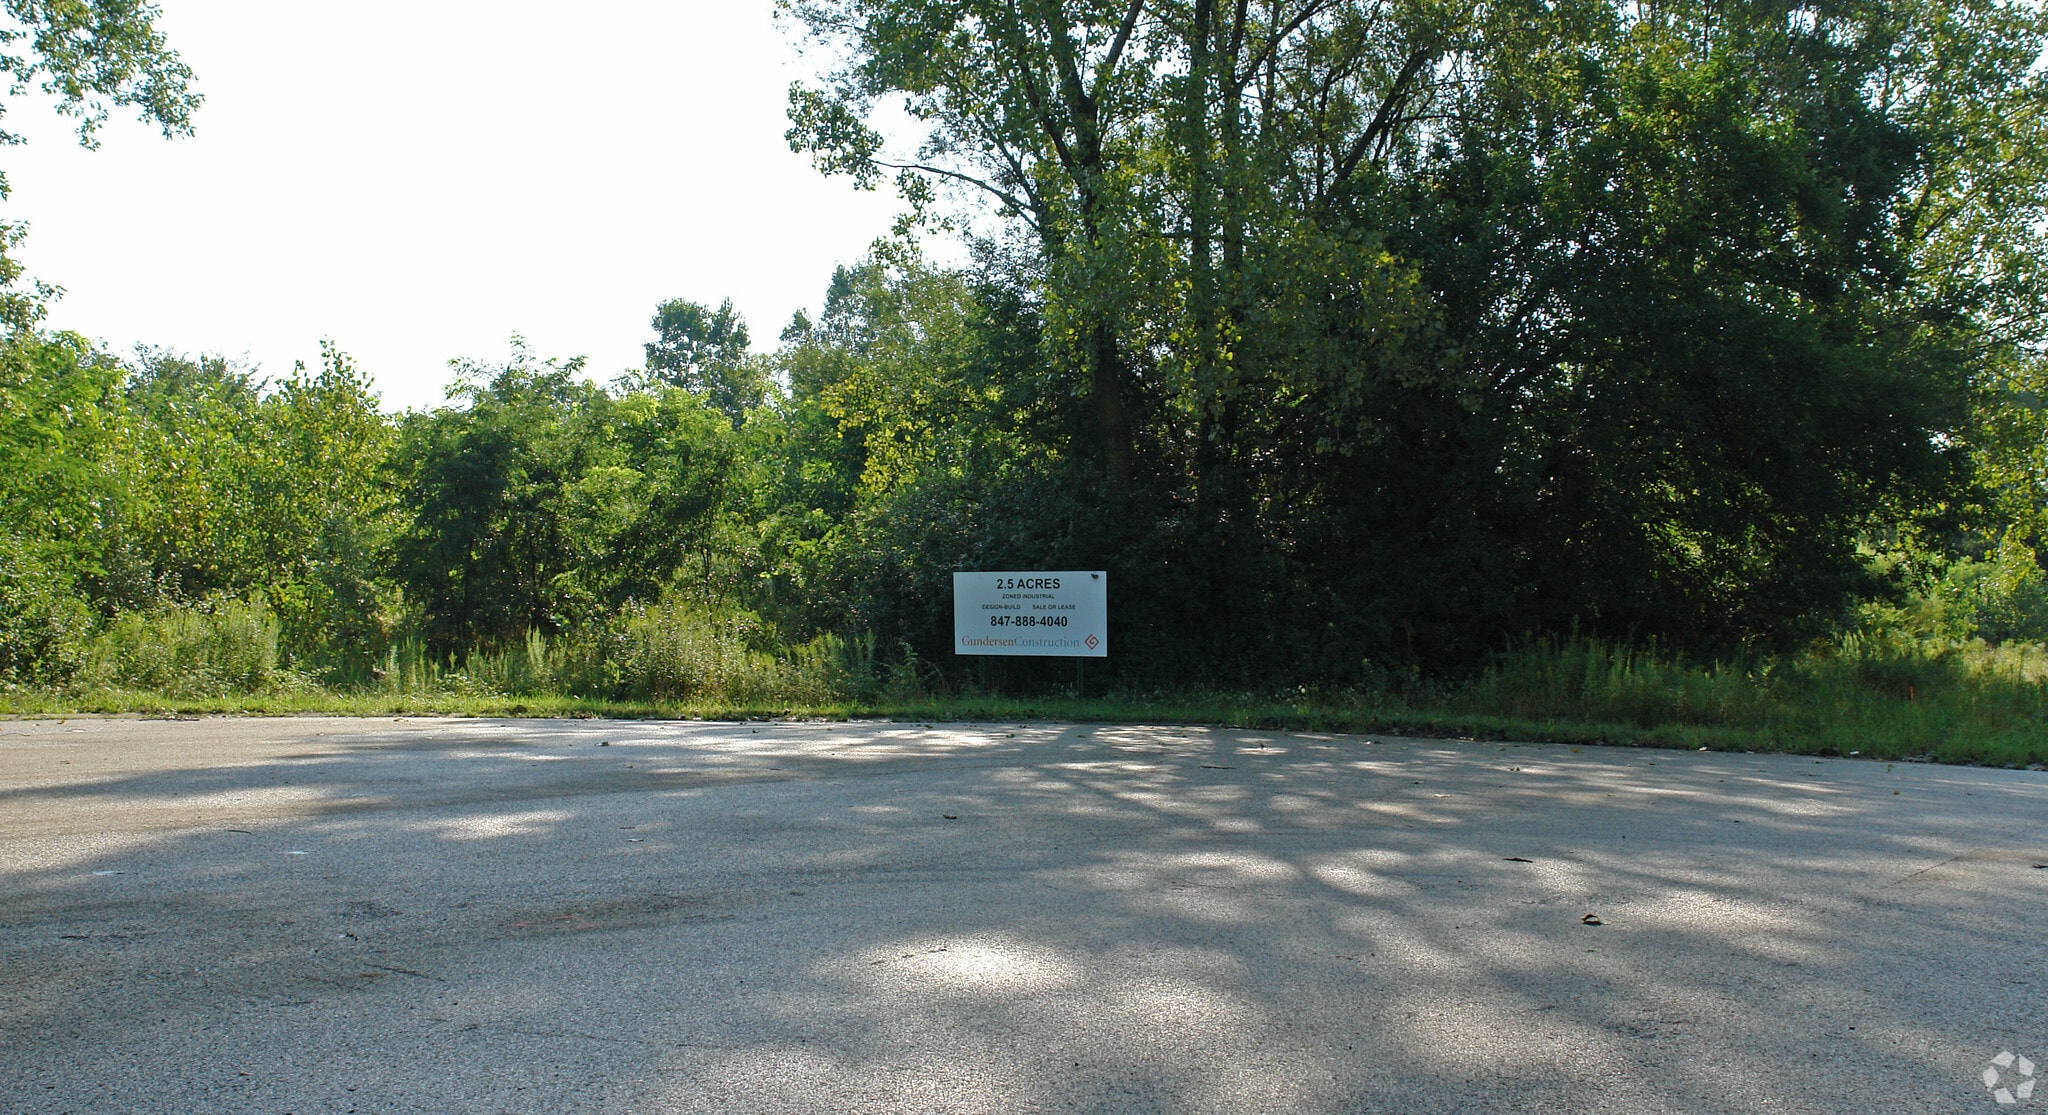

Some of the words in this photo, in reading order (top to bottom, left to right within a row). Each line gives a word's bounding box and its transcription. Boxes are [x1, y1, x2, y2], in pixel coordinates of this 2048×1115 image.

[996, 578, 1014, 589] 2.5
[1016, 578, 1061, 589] ACRES
[990, 615, 1068, 627] 847-888-4040
